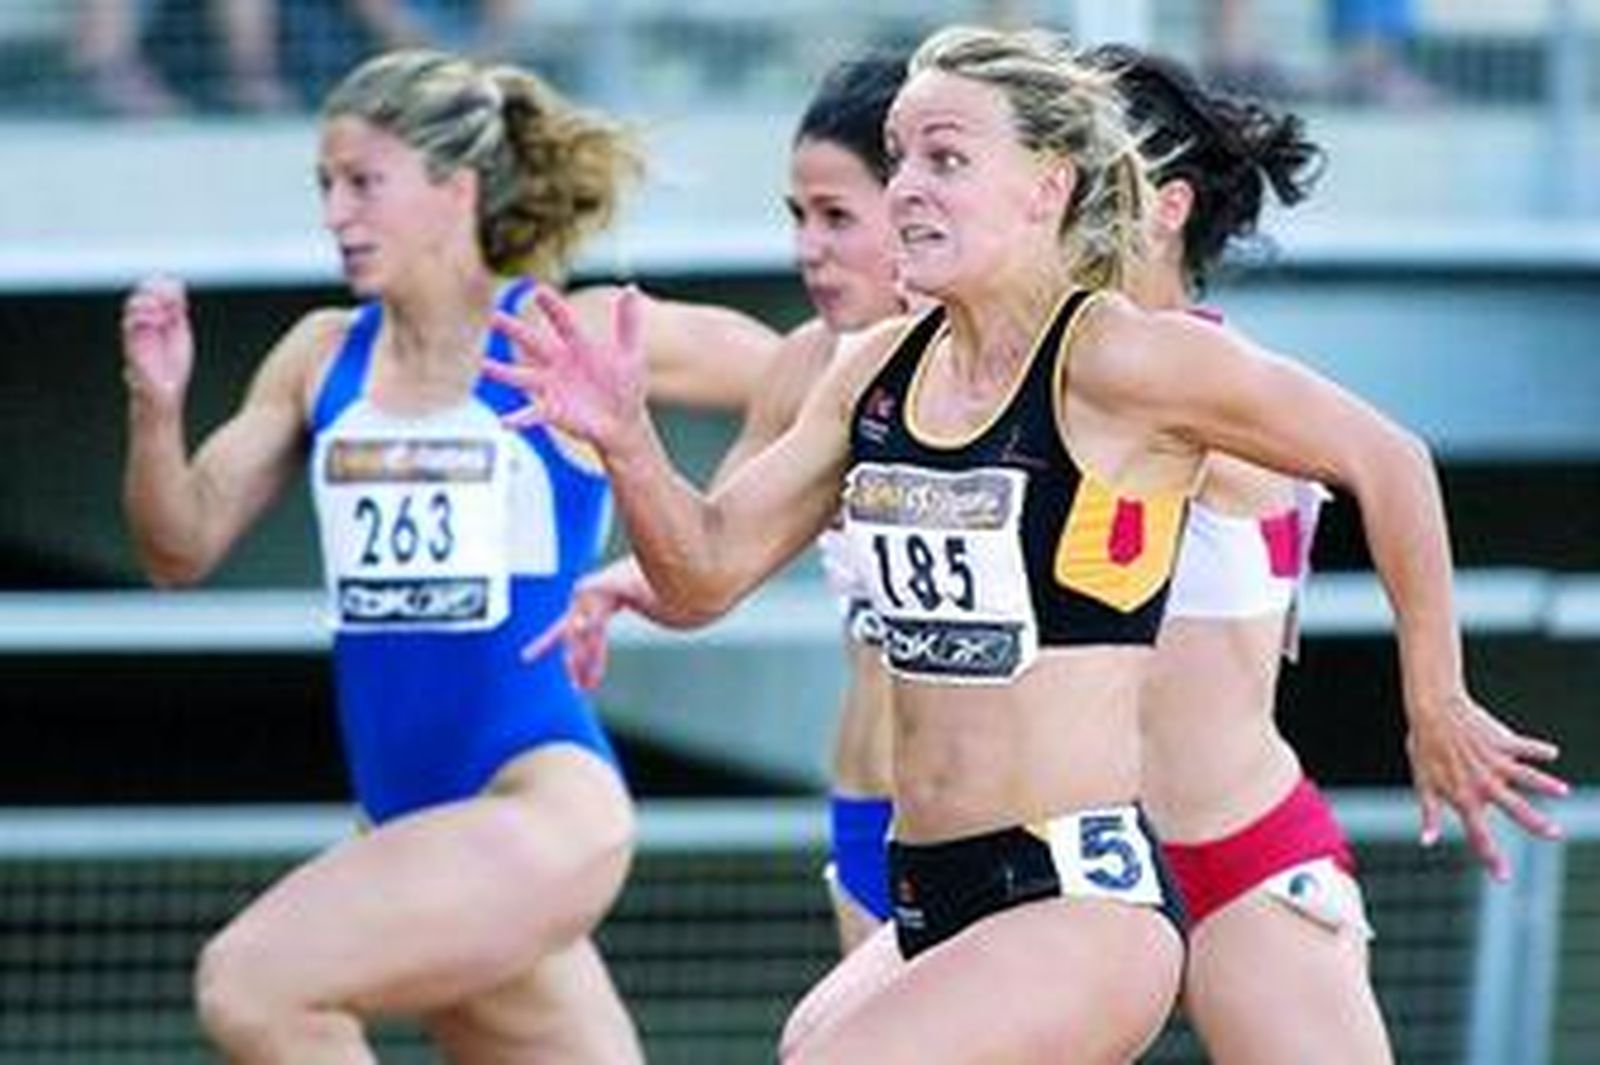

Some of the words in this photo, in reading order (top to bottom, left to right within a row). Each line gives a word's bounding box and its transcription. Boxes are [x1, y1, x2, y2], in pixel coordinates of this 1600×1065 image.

[355, 493, 454, 566] 263
[873, 534, 975, 611] 185
[1079, 815, 1142, 891] 5
